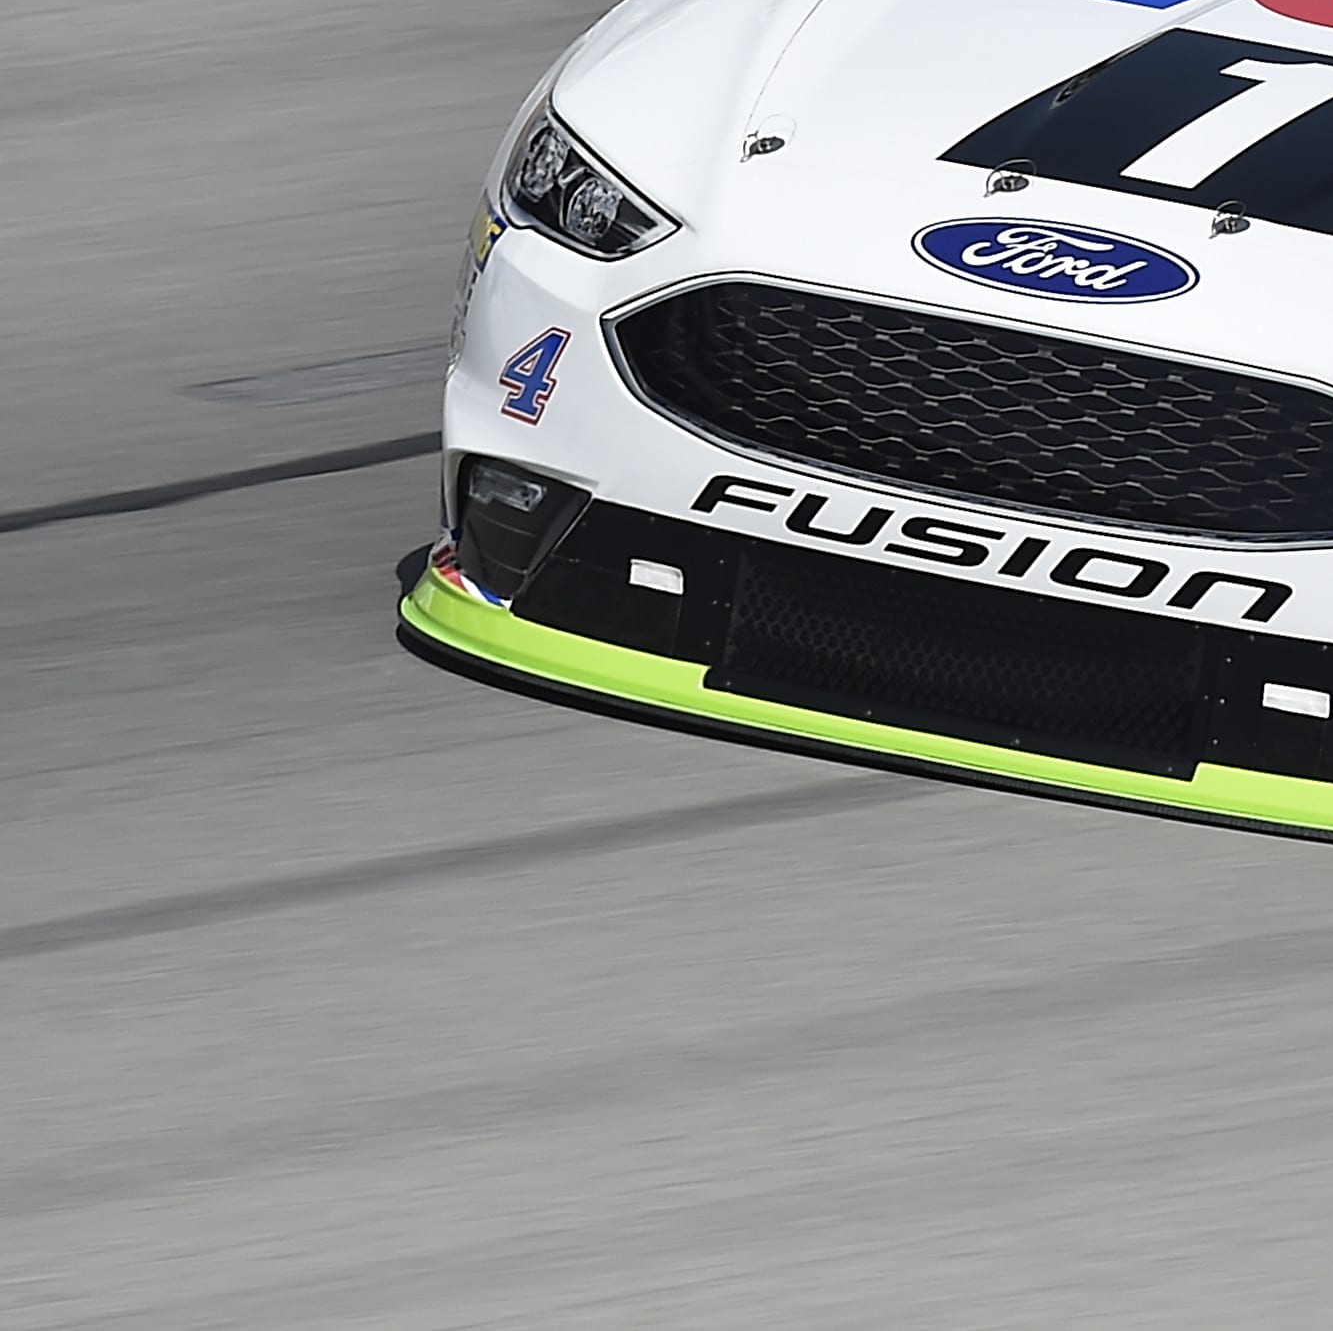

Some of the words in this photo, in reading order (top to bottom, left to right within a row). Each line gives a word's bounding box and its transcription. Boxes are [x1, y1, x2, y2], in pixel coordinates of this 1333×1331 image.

[961, 224, 1148, 292] Ford
[499, 326, 571, 426] 4
[689, 473, 1293, 624] FUSION
